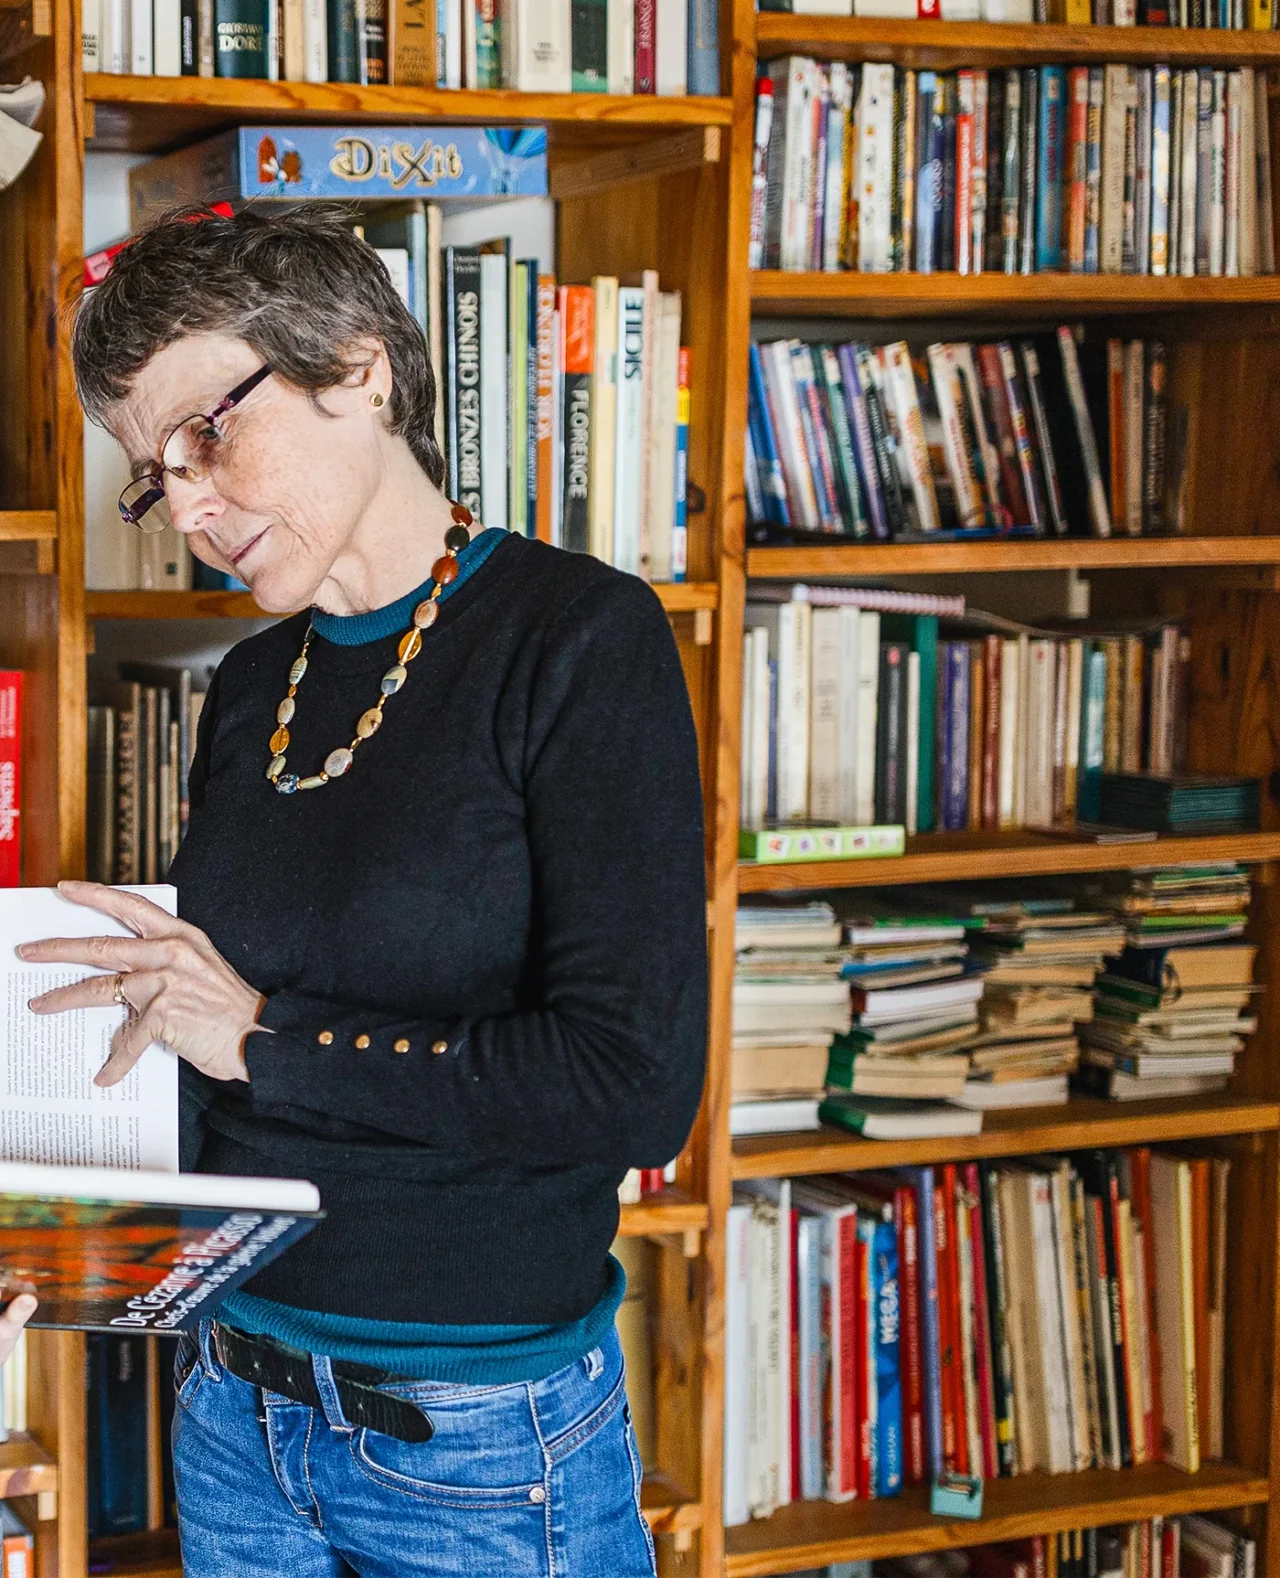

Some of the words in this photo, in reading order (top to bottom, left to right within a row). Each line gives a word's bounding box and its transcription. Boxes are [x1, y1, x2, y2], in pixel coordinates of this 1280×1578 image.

[456, 291, 479, 386] CHINOIS
[624, 296, 644, 382] SICILE
[456, 388, 479, 488] BRONZES
[568, 388, 590, 500] FLORENCE
[172, 1255, 215, 1267] à
[181, 1212, 264, 1257] Picasso
[110, 1311, 156, 1328] De
[126, 1265, 205, 1311] Cézanne
